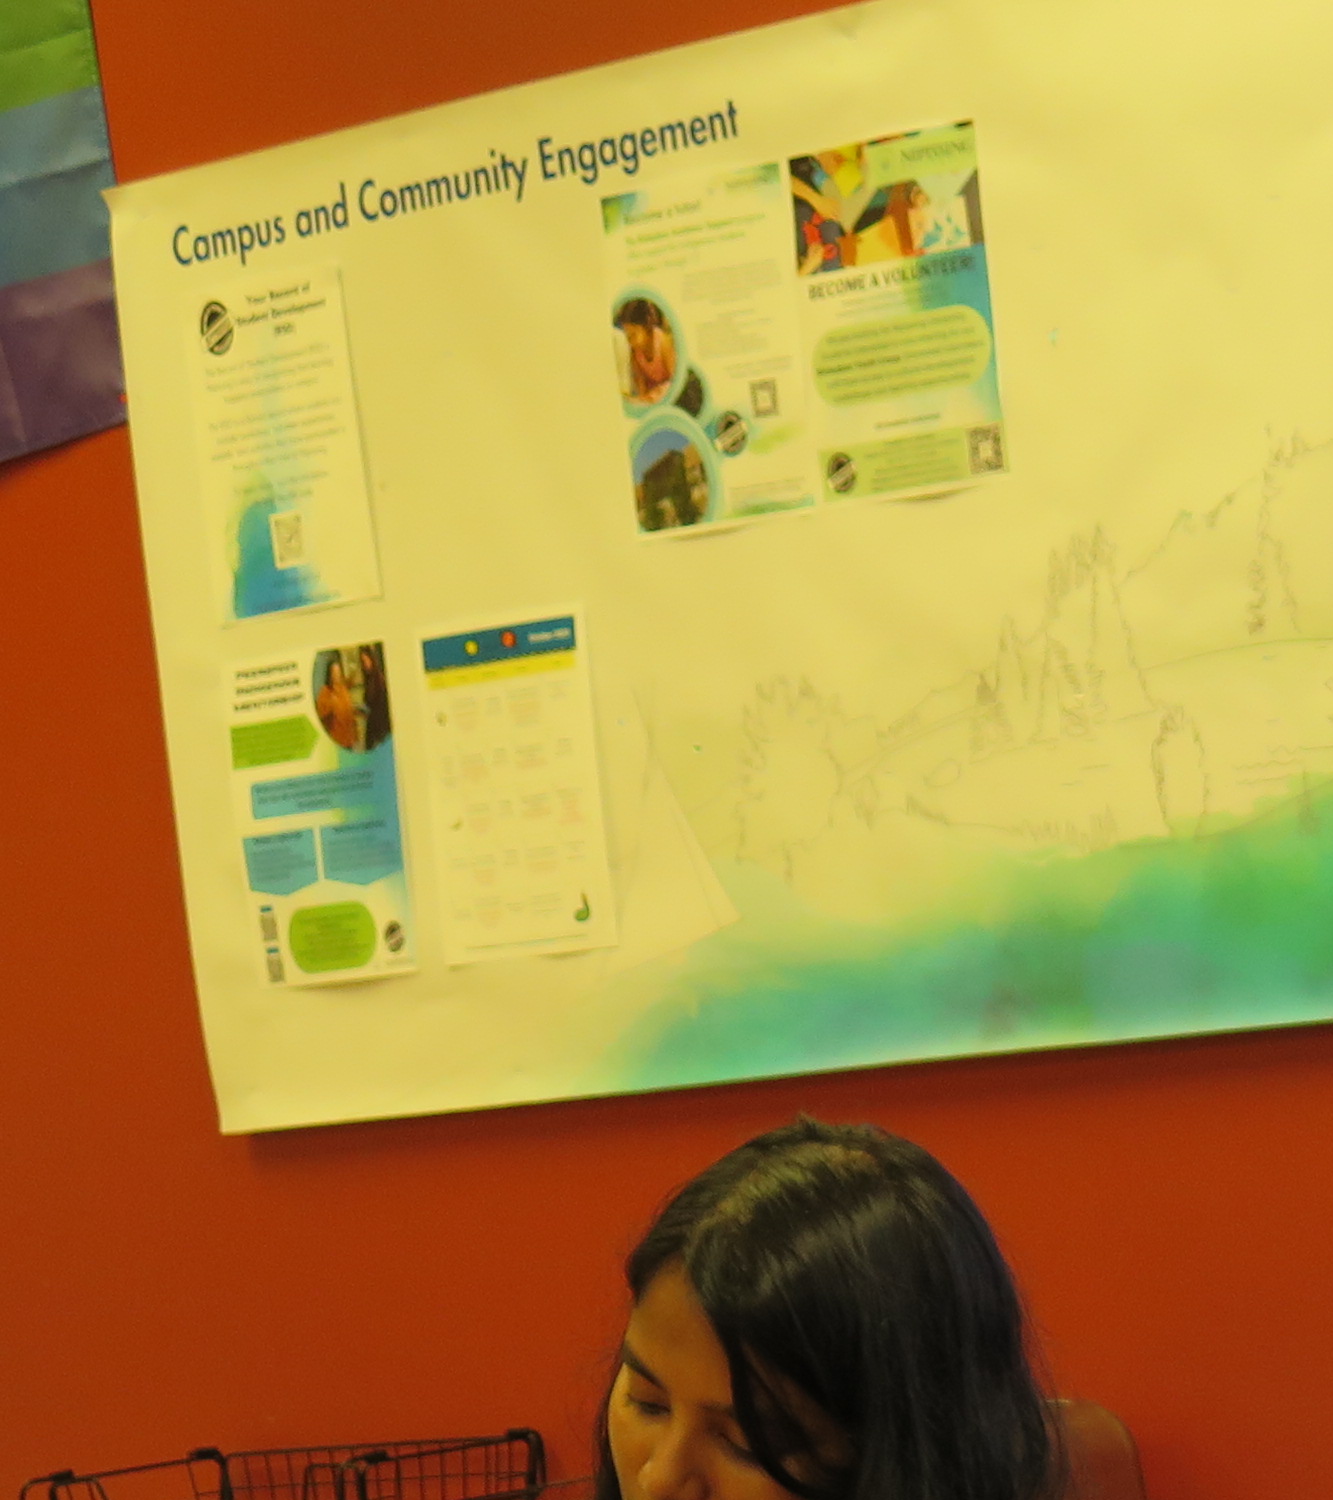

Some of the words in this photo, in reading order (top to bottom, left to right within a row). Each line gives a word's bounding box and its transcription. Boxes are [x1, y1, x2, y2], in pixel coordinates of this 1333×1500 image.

[172, 214, 286, 266] Campus
[295, 182, 350, 238] and
[357, 149, 528, 223] Community
[538, 100, 739, 184] Engagement
